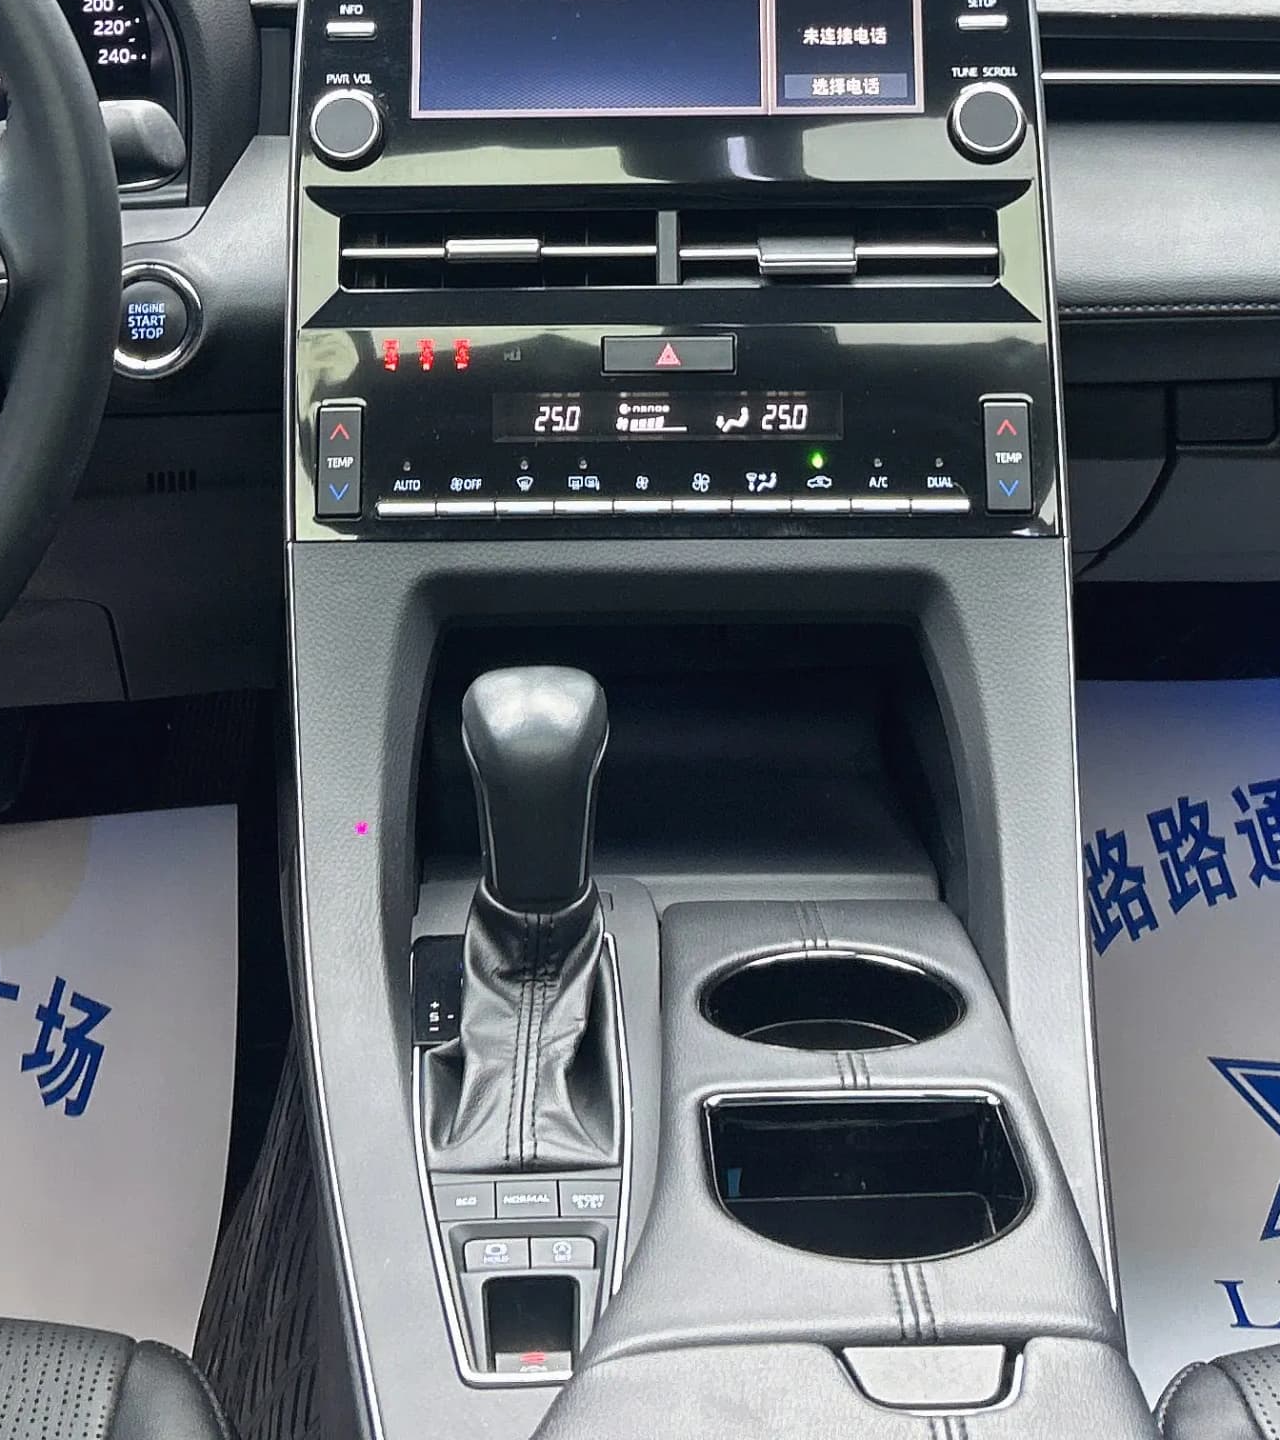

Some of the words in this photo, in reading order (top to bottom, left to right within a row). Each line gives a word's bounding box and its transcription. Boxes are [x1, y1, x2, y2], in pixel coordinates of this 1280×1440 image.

[339, 4, 364, 15] INFO
[93, 20, 124, 36] 220
[803, 26, 888, 45] 未连接电话
[98, 48, 131, 64] 240
[952, 67, 979, 78] TUNE
[983, 66, 1019, 78] SCROLL
[326, 73, 350, 85] PWR
[353, 73, 373, 85] VOL
[811, 77, 881, 96] 选择电话
[128, 303, 166, 315] ENGINE
[128, 315, 167, 328] START
[131, 327, 164, 340] STOP
[535, 406, 582, 432] 25.0
[761, 404, 809, 431] 25.0
[327, 457, 354, 468] TEMP
[995, 452, 1022, 464] TEMP
[393, 480, 420, 491] AUTO
[464, 479, 482, 491] OFF
[869, 476, 888, 488] A/C
[927, 476, 953, 488] DUAL
[503, 1194, 551, 1205] NORMAL
